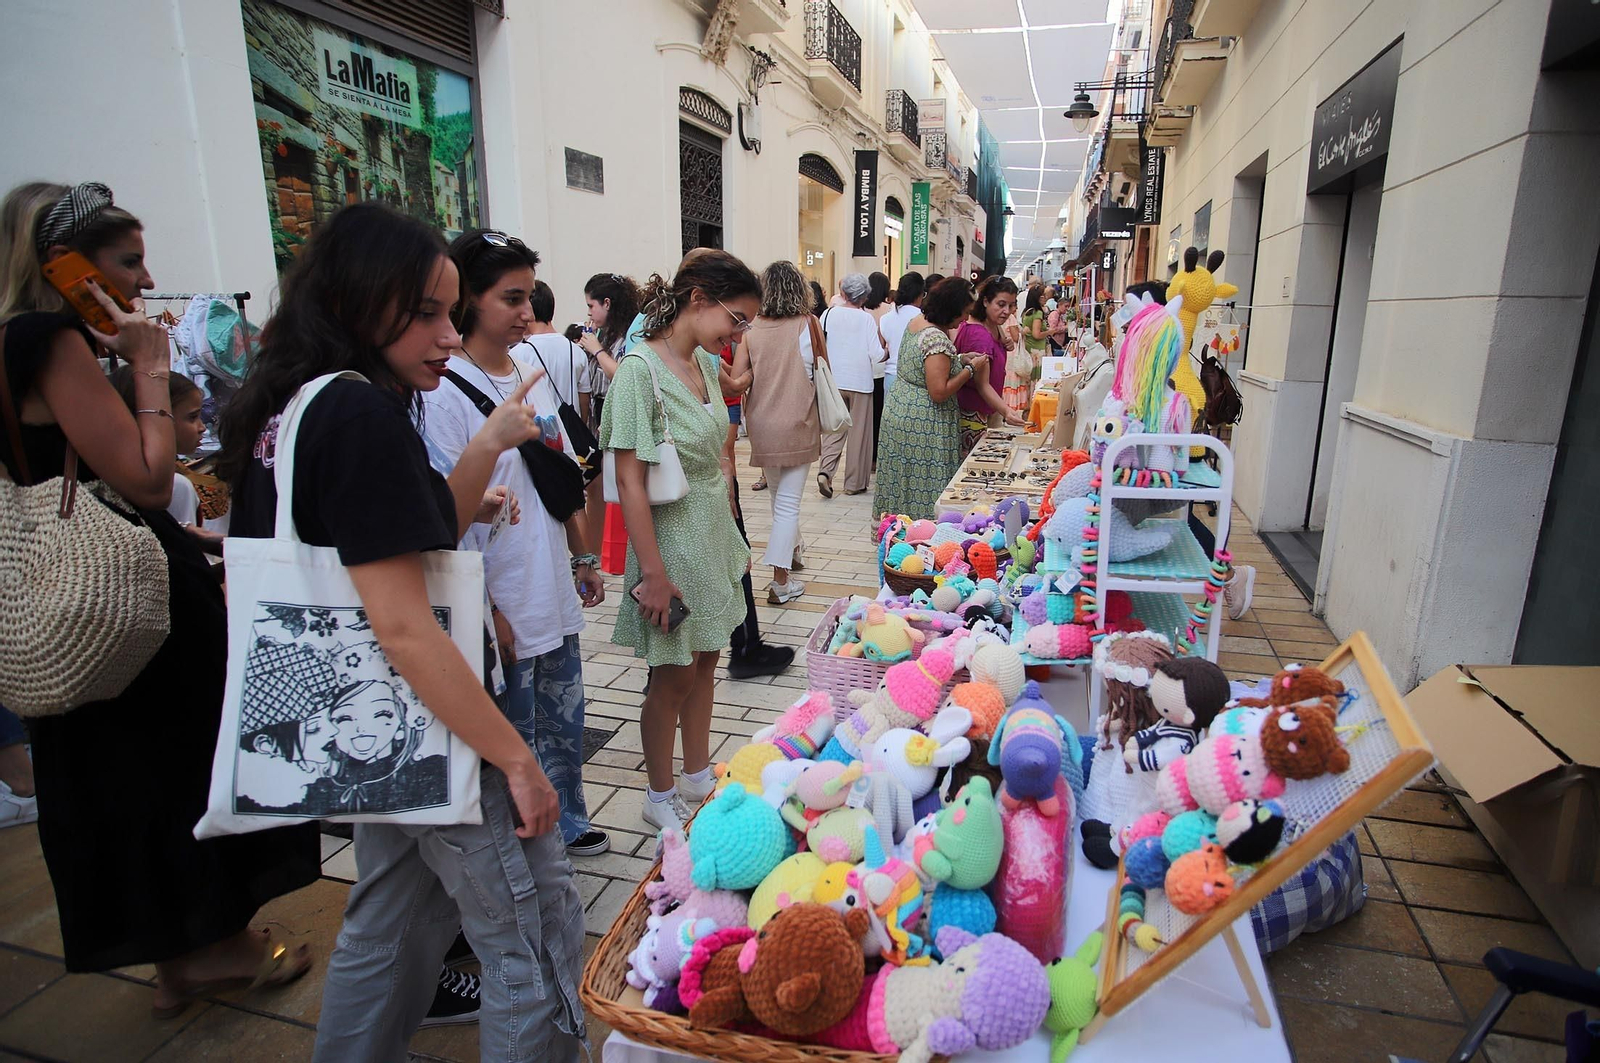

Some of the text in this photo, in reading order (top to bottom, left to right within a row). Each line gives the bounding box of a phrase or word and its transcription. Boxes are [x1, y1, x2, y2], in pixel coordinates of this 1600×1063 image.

[328, 88, 412, 119] SE SIENTA A LA MESA
[860, 169, 871, 238] BIMBA Y LOLA
[1143, 148, 1156, 223] LYNCIS REAL ESTATE
[914, 209, 920, 221] DE
[920, 203, 928, 245] CARCASAS
[913, 243, 920, 255] LA
